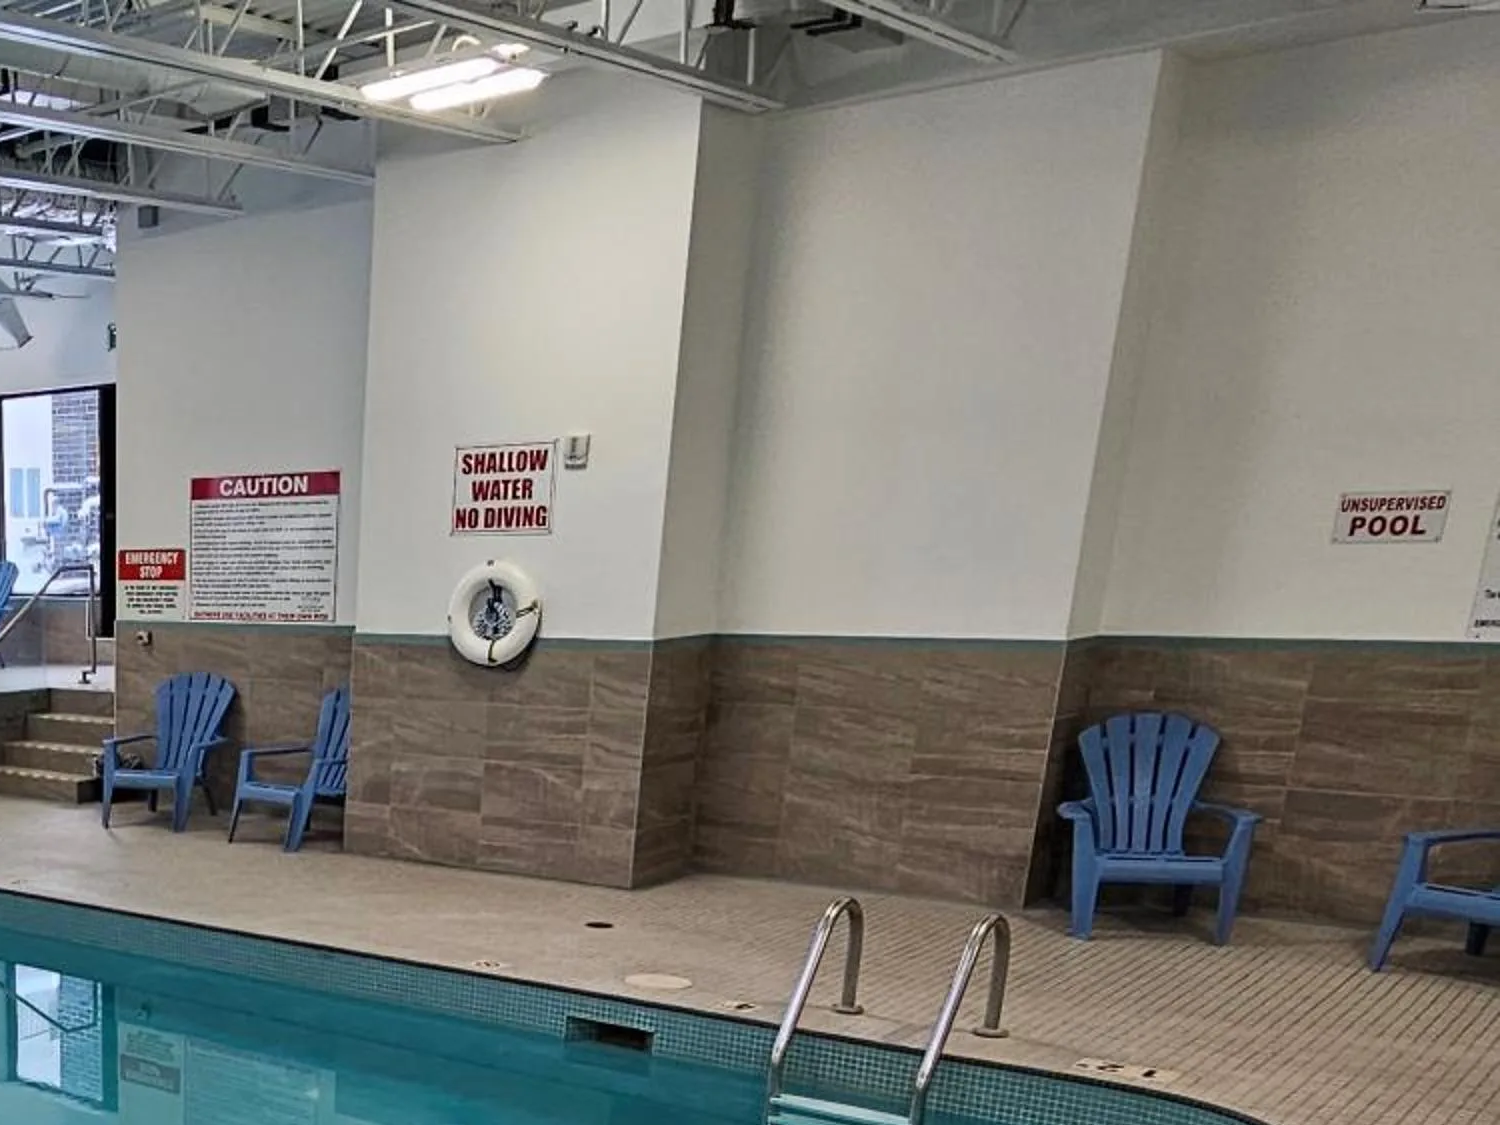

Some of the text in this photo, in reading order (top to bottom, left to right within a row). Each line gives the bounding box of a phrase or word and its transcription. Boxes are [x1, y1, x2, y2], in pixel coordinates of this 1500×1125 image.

[461, 450, 548, 475] SHALLOW
[219, 475, 308, 496] CAUTION
[471, 478, 533, 501] WATER
[1341, 496, 1447, 513] UNSUPERVISED
[455, 505, 548, 529] NO DIVING
[1348, 515, 1427, 537] POOL
[125, 551, 179, 565] EMERGENCY
[139, 565, 163, 578] STOP
